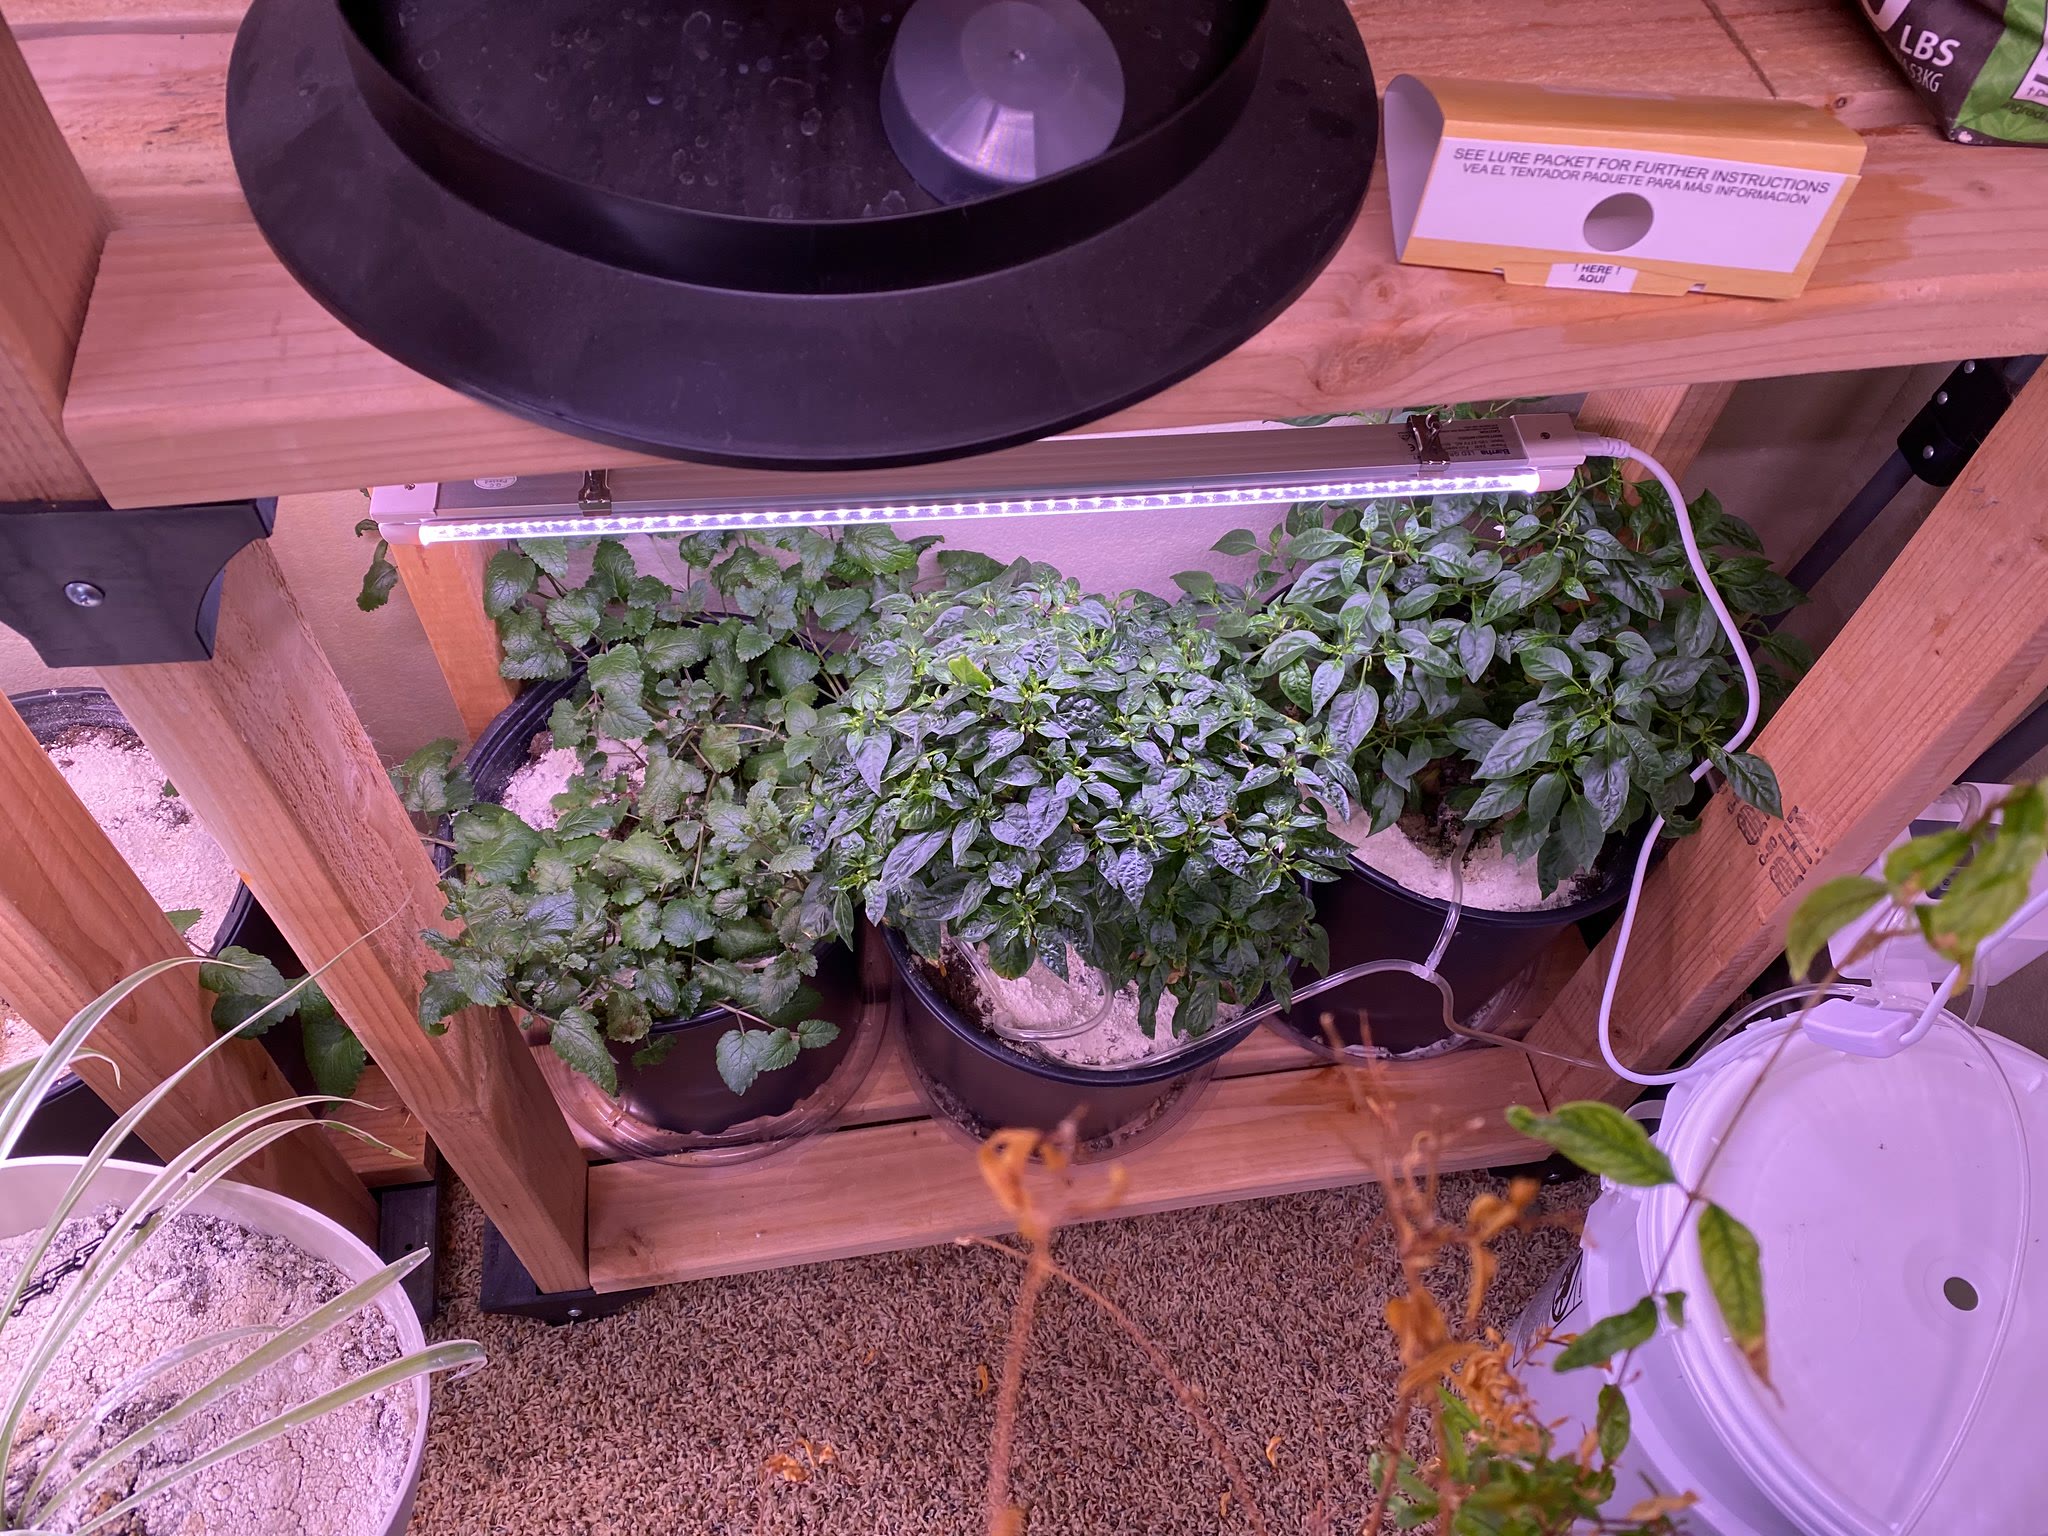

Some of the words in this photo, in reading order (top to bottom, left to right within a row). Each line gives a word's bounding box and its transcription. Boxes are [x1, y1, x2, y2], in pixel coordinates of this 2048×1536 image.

[1900, 25, 1960, 67] LBS
[1453, 148, 1486, 161] SEE
[1488, 151, 1530, 165] LURE
[1533, 153, 1596, 168] PACKET
[1597, 158, 1633, 172] FOR
[1633, 161, 1709, 180] FURTHER
[1711, 169, 1830, 194] INSTRUCTIONS
[1462, 163, 1489, 174] VEA
[1490, 165, 1507, 176] EL
[1510, 166, 1580, 181] TENTADOR
[1582, 172, 1642, 186] PAQUETE
[1646, 177, 1682, 191] PARA
[1581, 264, 1614, 275] HERE
